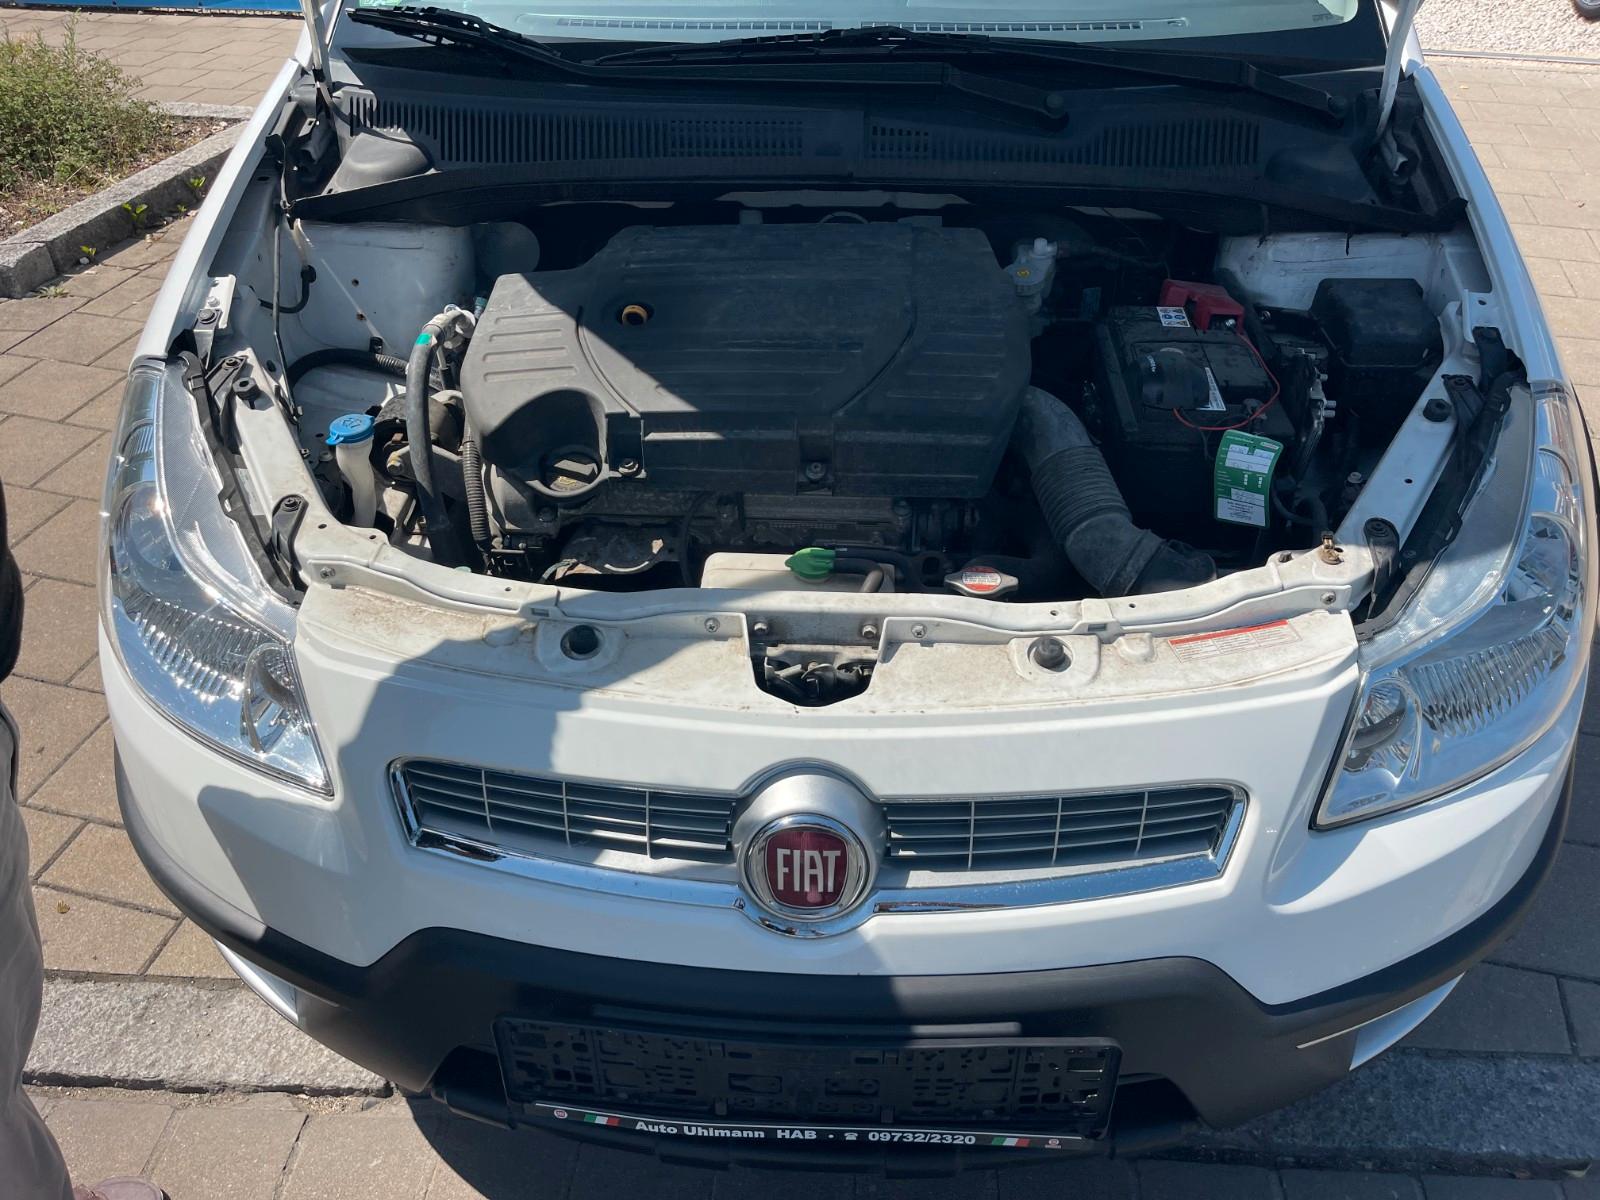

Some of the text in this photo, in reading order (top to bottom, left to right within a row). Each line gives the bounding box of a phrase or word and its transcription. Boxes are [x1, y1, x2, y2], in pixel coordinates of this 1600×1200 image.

[776, 848, 841, 893] FIAT
[635, 1121, 976, 1145] Auto Uhlmann HAB 09732/2320
